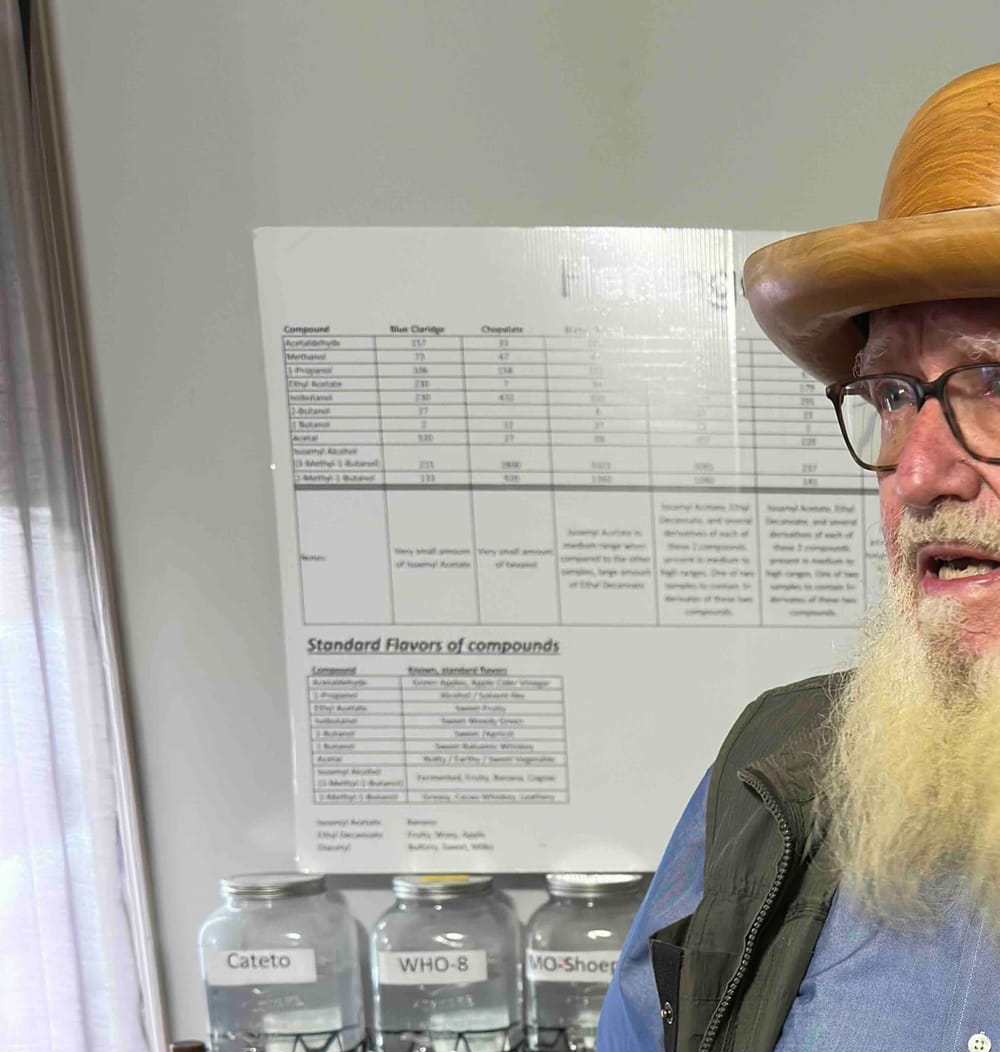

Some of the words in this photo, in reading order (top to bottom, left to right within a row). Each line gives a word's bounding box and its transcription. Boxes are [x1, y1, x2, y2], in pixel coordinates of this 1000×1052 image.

[284, 325, 330, 335] Compound
[390, 325, 408, 335] Blue
[308, 638, 381, 651] Standard
[386, 638, 442, 651] Flavors
[447, 638, 465, 653] of
[467, 638, 560, 653] compounds
[312, 666, 357, 675] Compound
[227, 952, 291, 969] Cateto
[399, 956, 469, 974] WHO-8
